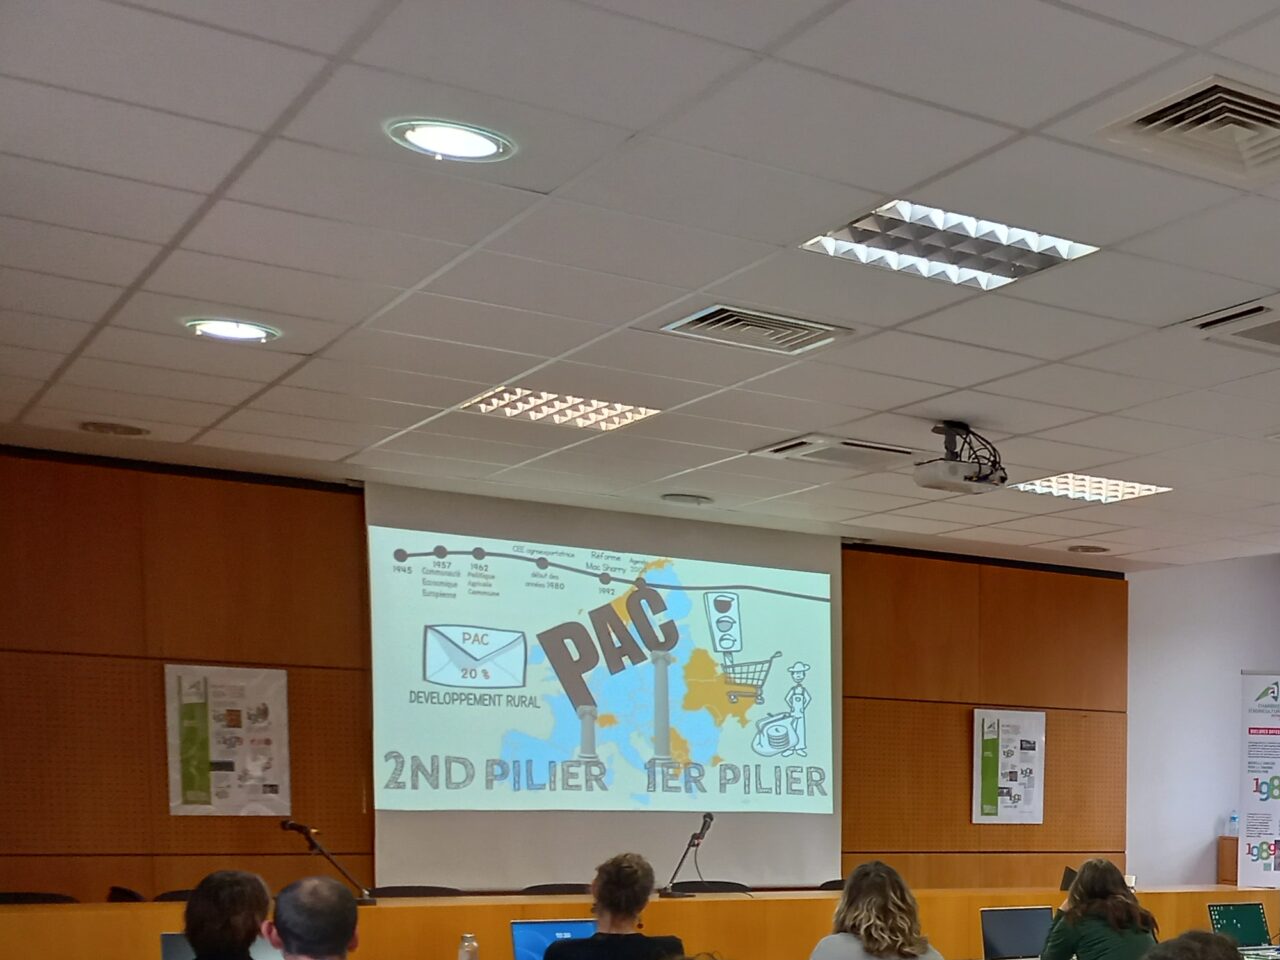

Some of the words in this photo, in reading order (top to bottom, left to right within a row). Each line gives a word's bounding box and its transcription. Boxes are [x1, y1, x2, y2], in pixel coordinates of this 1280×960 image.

[393, 566, 412, 574] 1945
[433, 561, 452, 569] 1957
[470, 563, 489, 572] 1962
[586, 562, 601, 571] Mac
[546, 581, 565, 590] 1980
[599, 587, 615, 596] 1992
[462, 632, 489, 645] PAC
[536, 587, 679, 713] PAC
[461, 668, 477, 680] 20
[409, 690, 503, 707] DEVELOPPEMENT
[506, 694, 541, 709] RURAL
[384, 751, 475, 790] 2ND
[485, 758, 608, 791] PILIER
[644, 757, 707, 793] 1ER
[719, 763, 828, 796] PILIER
[1246, 841, 1277, 862] 1989
